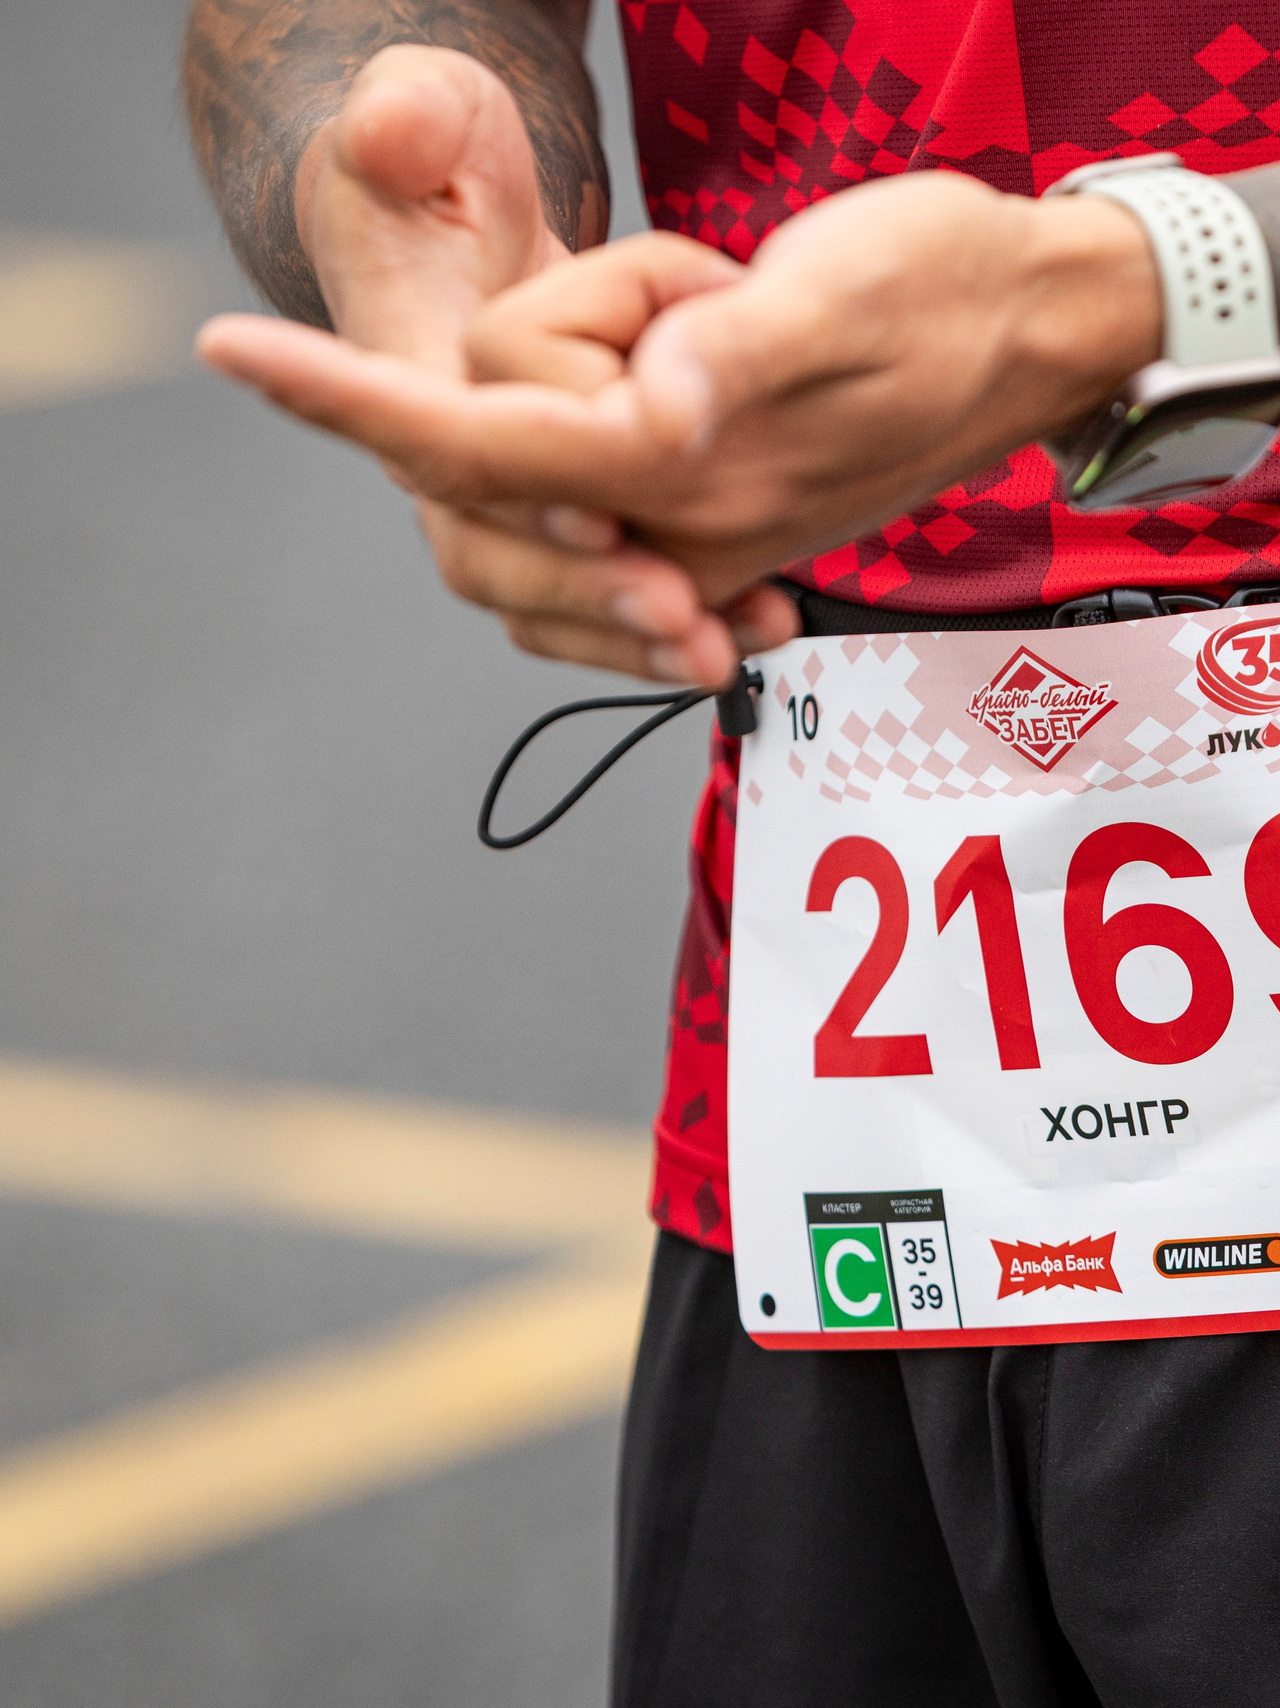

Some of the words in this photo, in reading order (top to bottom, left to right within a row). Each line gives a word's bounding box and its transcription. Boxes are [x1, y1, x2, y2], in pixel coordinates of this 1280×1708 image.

[787, 694, 818, 741] 10
[1000, 715, 1082, 743] ЗАБЕГ
[1040, 1098, 1190, 1142] ХОНГР
[821, 1202, 862, 1214] КЛАСТЕР
[894, 1205, 931, 1215] КАТЕГОРИЯ
[901, 1238, 936, 1264] 35
[1163, 1243, 1262, 1270] WINLINE
[1010, 1255, 1063, 1277] Альфа
[1066, 1254, 1105, 1272] Банк
[908, 1283, 943, 1310] 39
